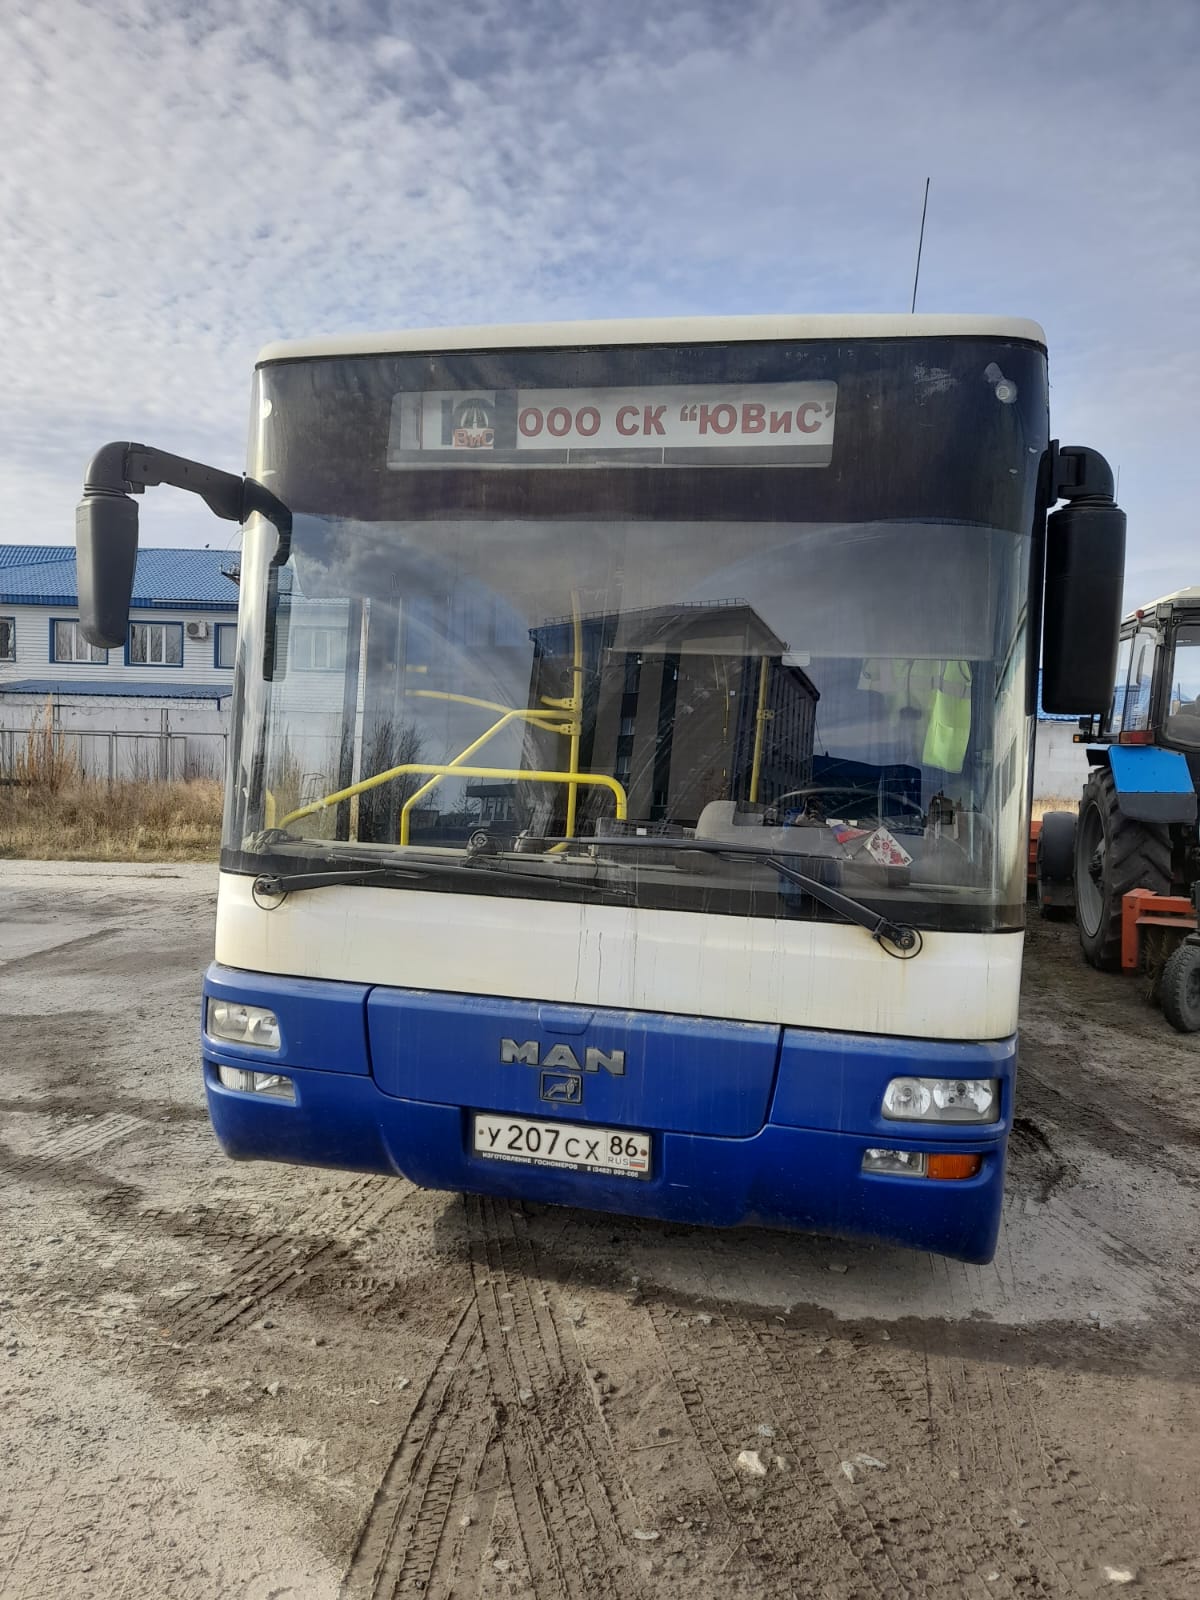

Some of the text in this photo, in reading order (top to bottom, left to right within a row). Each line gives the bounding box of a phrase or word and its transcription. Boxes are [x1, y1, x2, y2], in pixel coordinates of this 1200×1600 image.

[518, 405, 601, 438] ООО
[615, 403, 668, 436] СК
[500, 1037, 626, 1075] MAN
[609, 1135, 638, 1157] 86
[482, 1152, 532, 1164] ИЗГОТОВЛЕНИЕ
[534, 1158, 578, 1170] ГОСНОМЕРОВ
[607, 1156, 629, 1166] RUS
